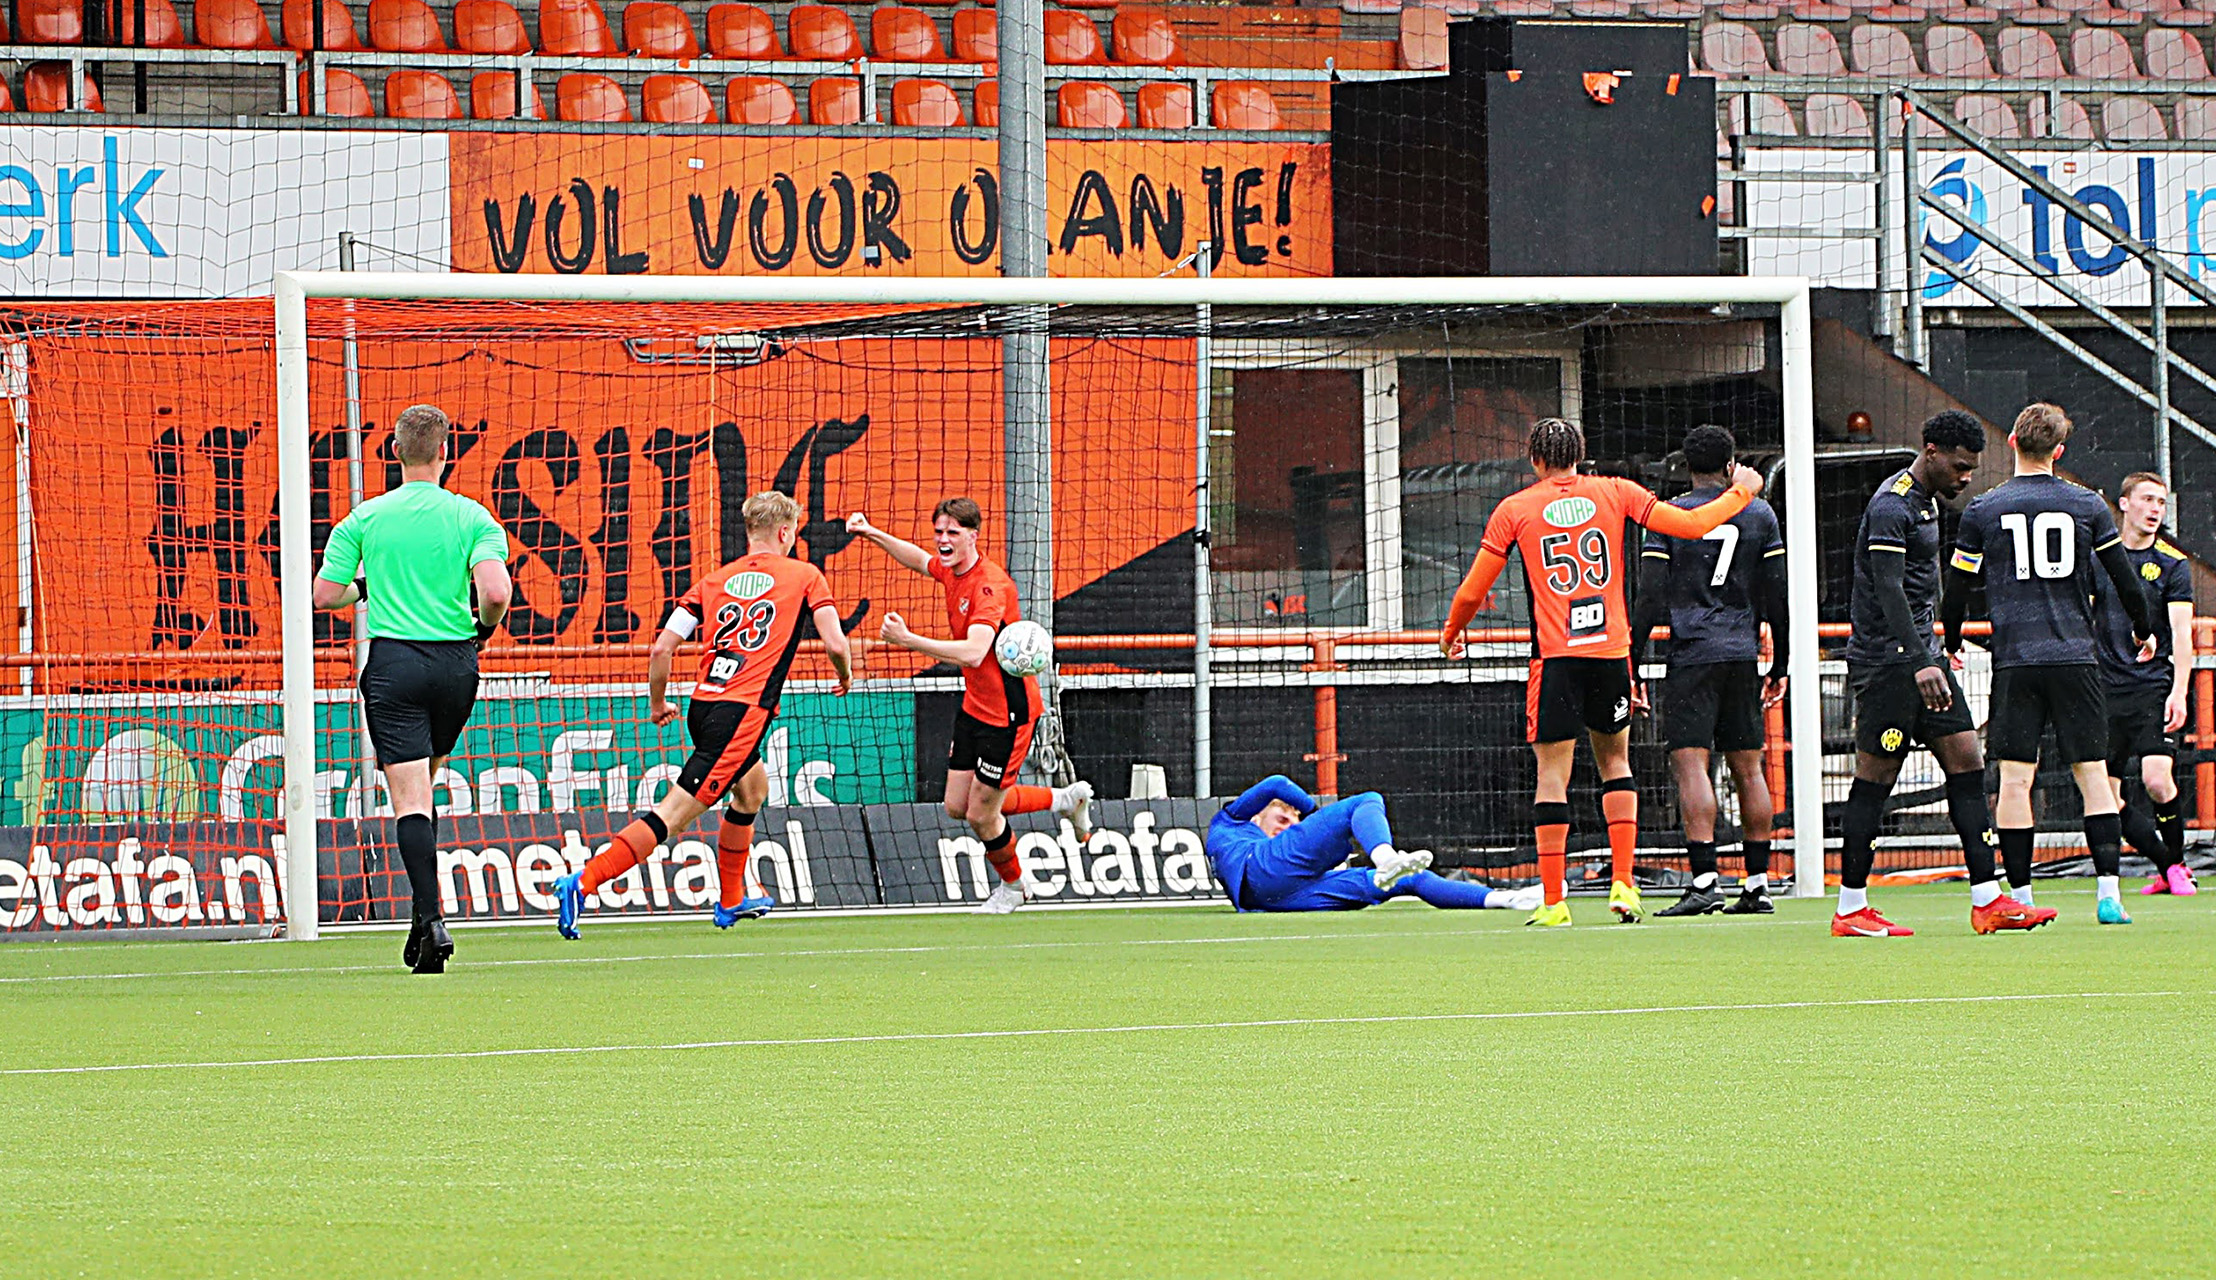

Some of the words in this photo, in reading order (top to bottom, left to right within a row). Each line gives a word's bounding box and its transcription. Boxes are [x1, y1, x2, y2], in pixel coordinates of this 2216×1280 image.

[484, 177, 650, 274] VOL
[688, 171, 912, 271] VOOR
[950, 161, 1297, 272] OANJE!
[1540, 527, 1612, 596] 59
[1702, 524, 1740, 587] 7
[2000, 512, 2076, 581] 10
[712, 599, 777, 652] 23
